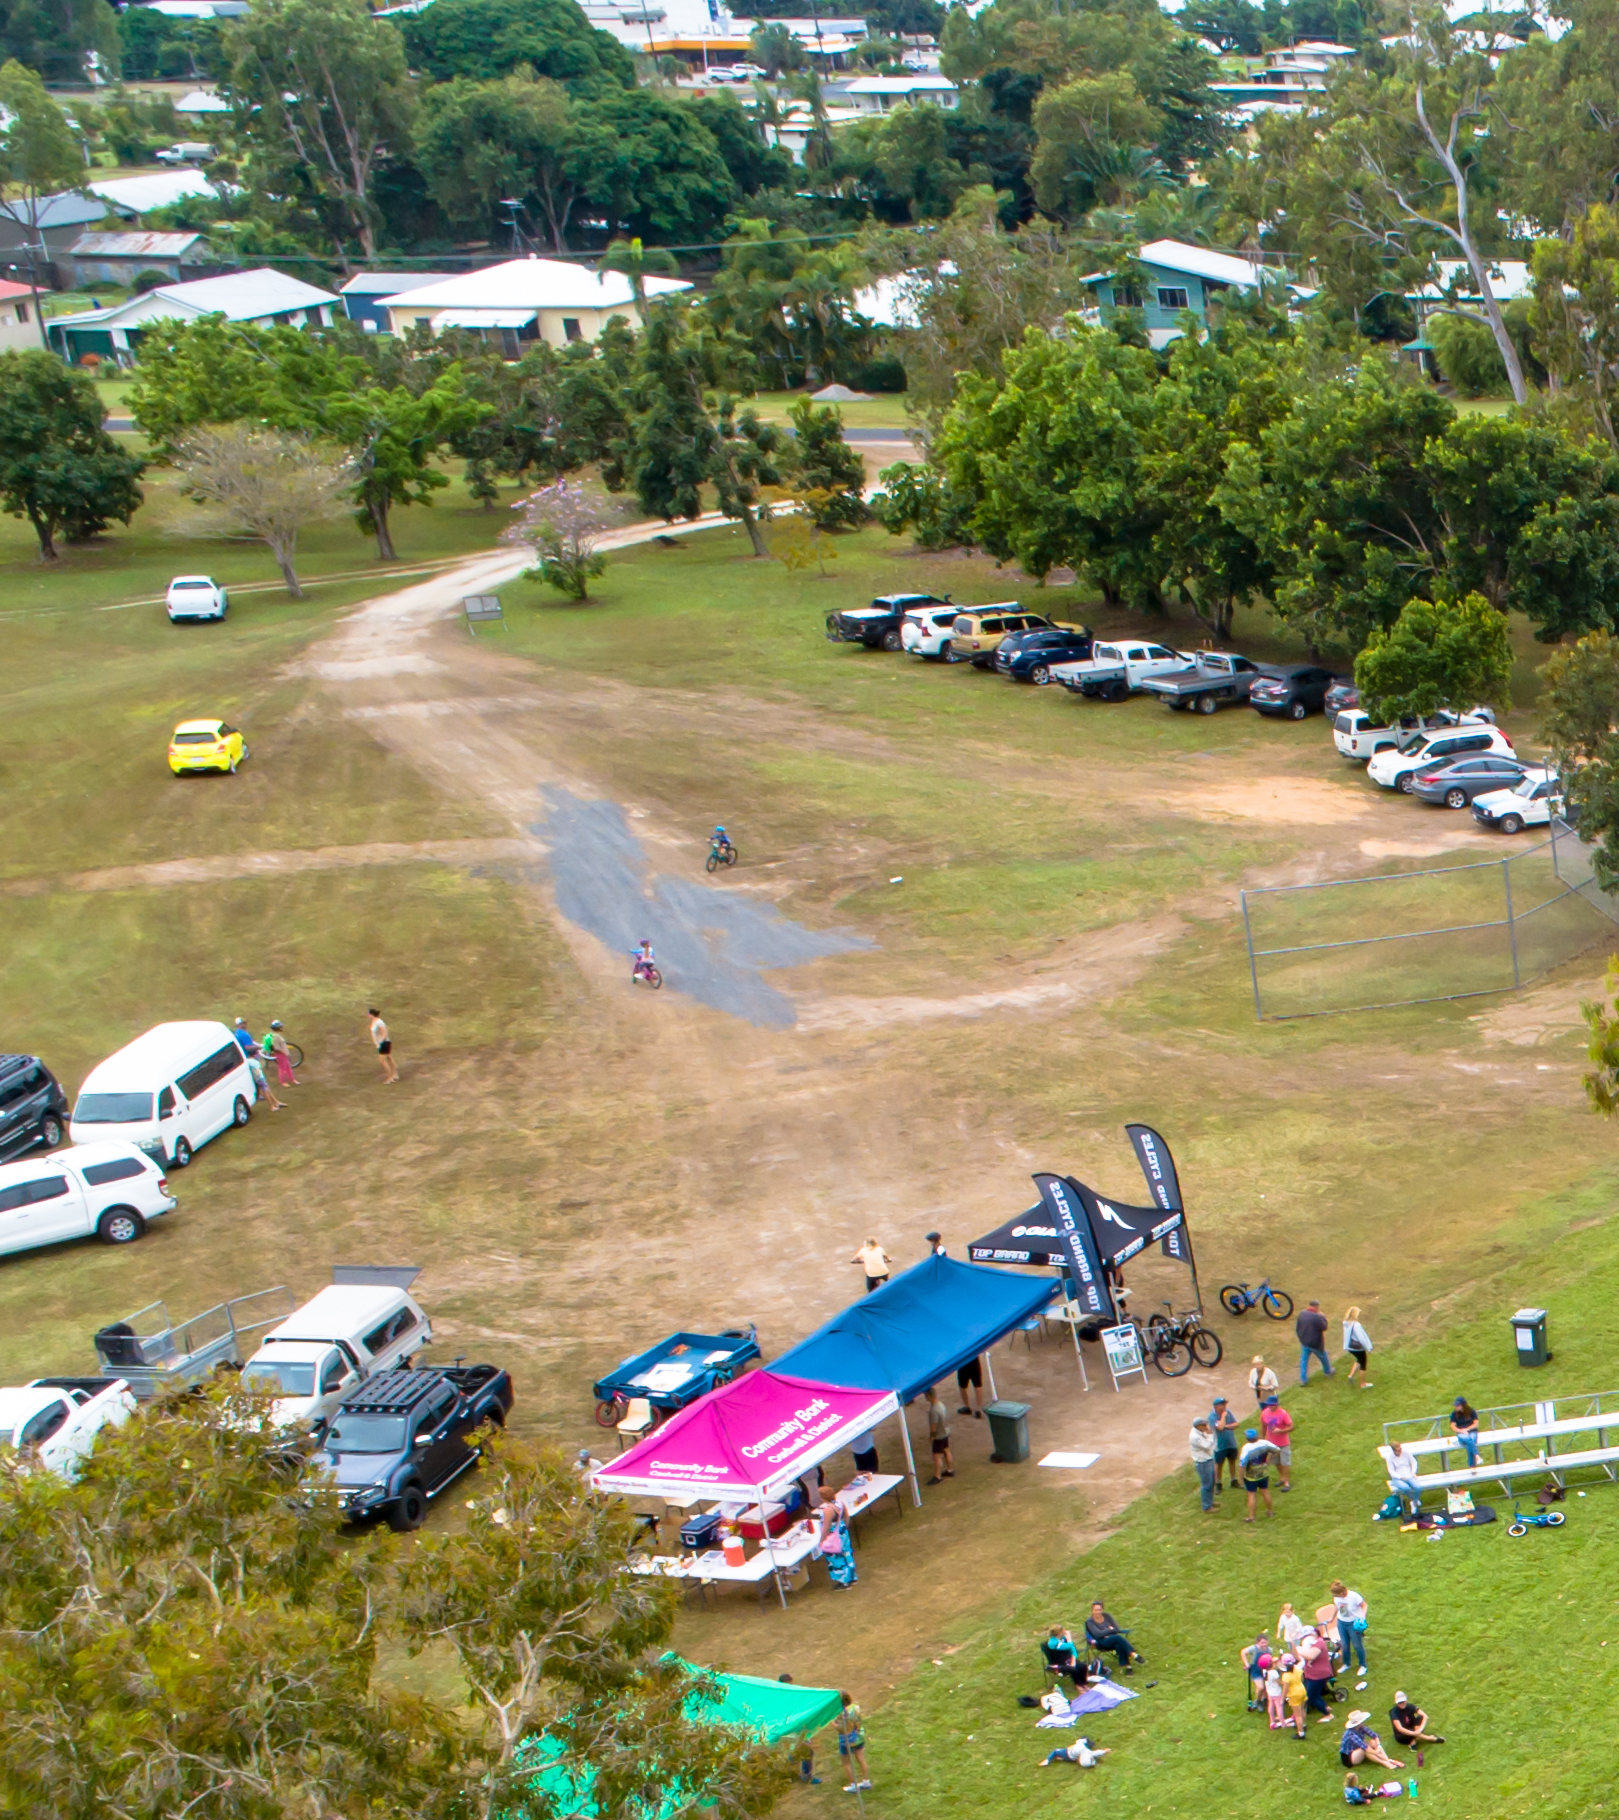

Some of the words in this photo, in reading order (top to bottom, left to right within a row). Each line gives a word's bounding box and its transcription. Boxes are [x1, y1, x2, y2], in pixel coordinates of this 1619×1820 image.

[973, 1248, 993, 1258] TOP
[994, 1250, 1030, 1260] BRAND
[741, 1418, 806, 1458] Community
[794, 1398, 831, 1422] Bank
[805, 1429, 817, 1442] &
[650, 1461, 704, 1474] Community
[704, 1464, 730, 1474] Bank
